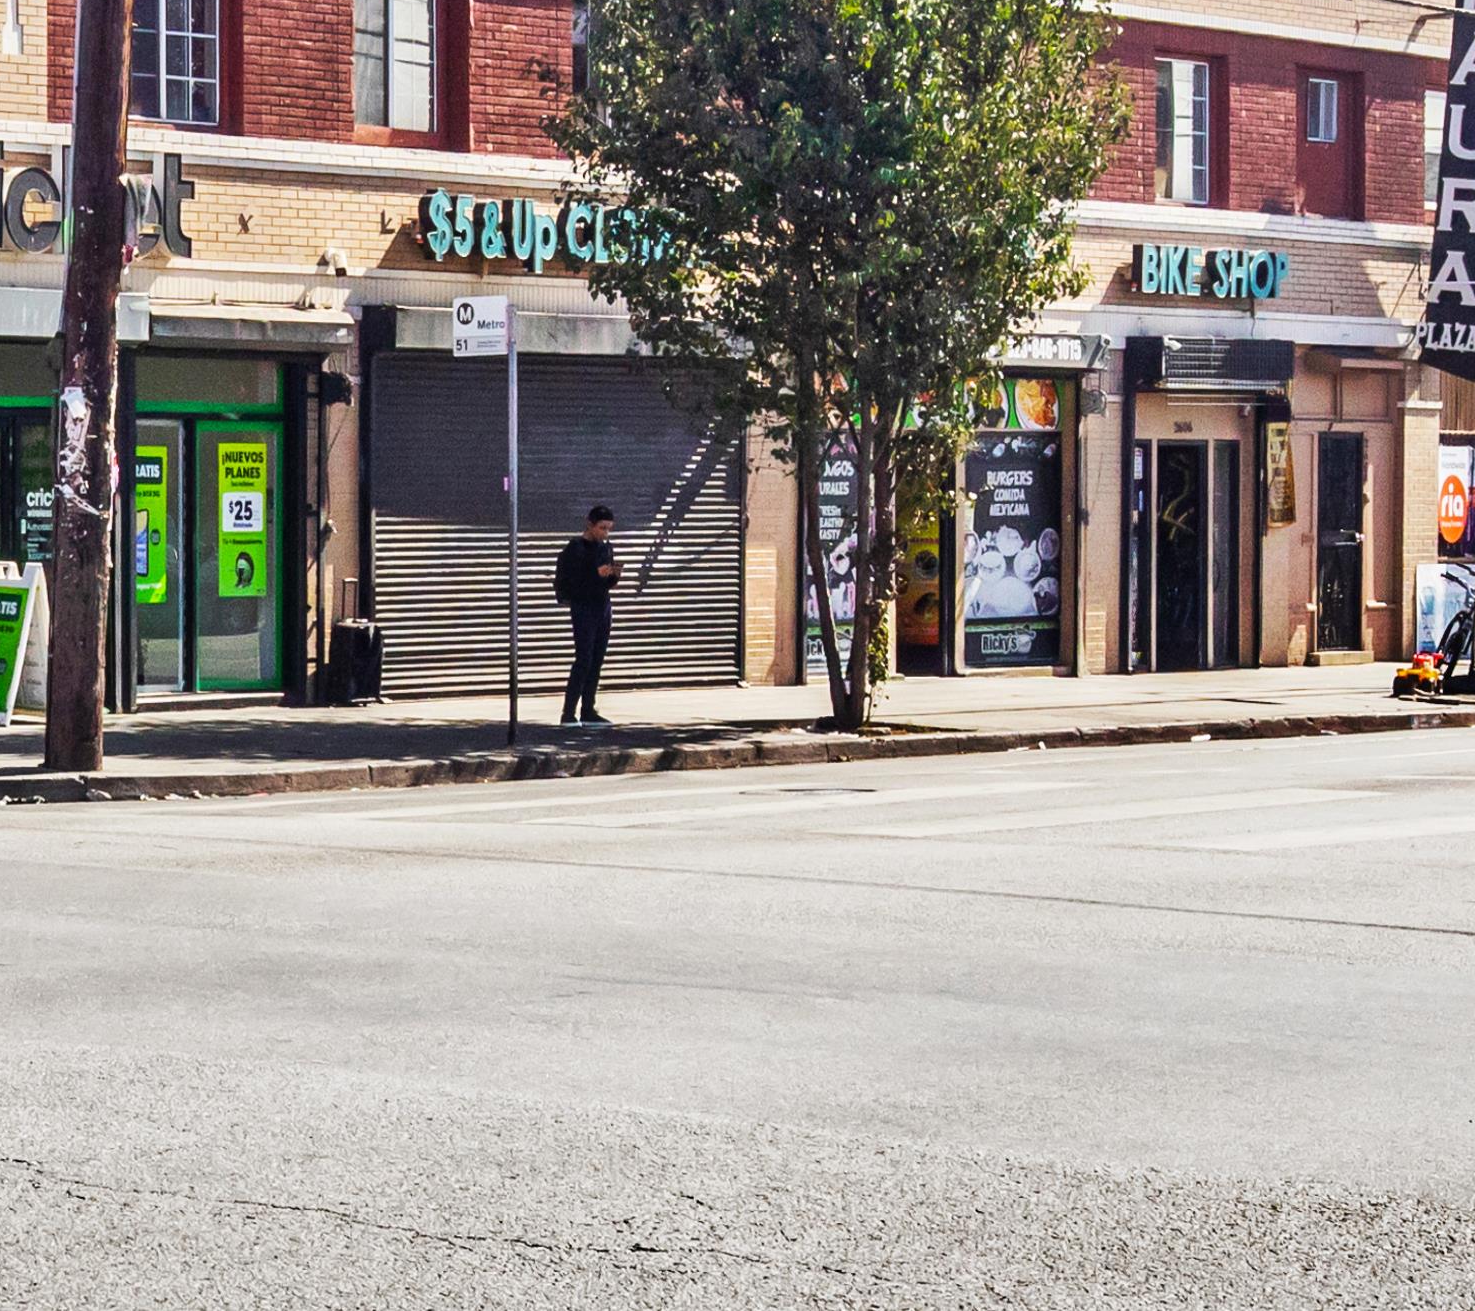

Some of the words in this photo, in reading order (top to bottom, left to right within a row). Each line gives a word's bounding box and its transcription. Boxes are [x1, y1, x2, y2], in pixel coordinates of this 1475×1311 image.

[427, 187, 475, 262] $5
[482, 200, 507, 259] &
[512, 197, 558, 274] Up
[1141, 243, 1203, 296] BIKE
[1213, 248, 1290, 299] SHOP
[477, 319, 506, 329] Metro
[456, 339, 468, 351] 51
[221, 451, 265, 465] ¡NUEVOS
[225, 467, 261, 479] PLANES
[986, 470, 1034, 486] BURGERS
[1441, 482, 1464, 518] ria
[228, 500, 253, 521] $25
